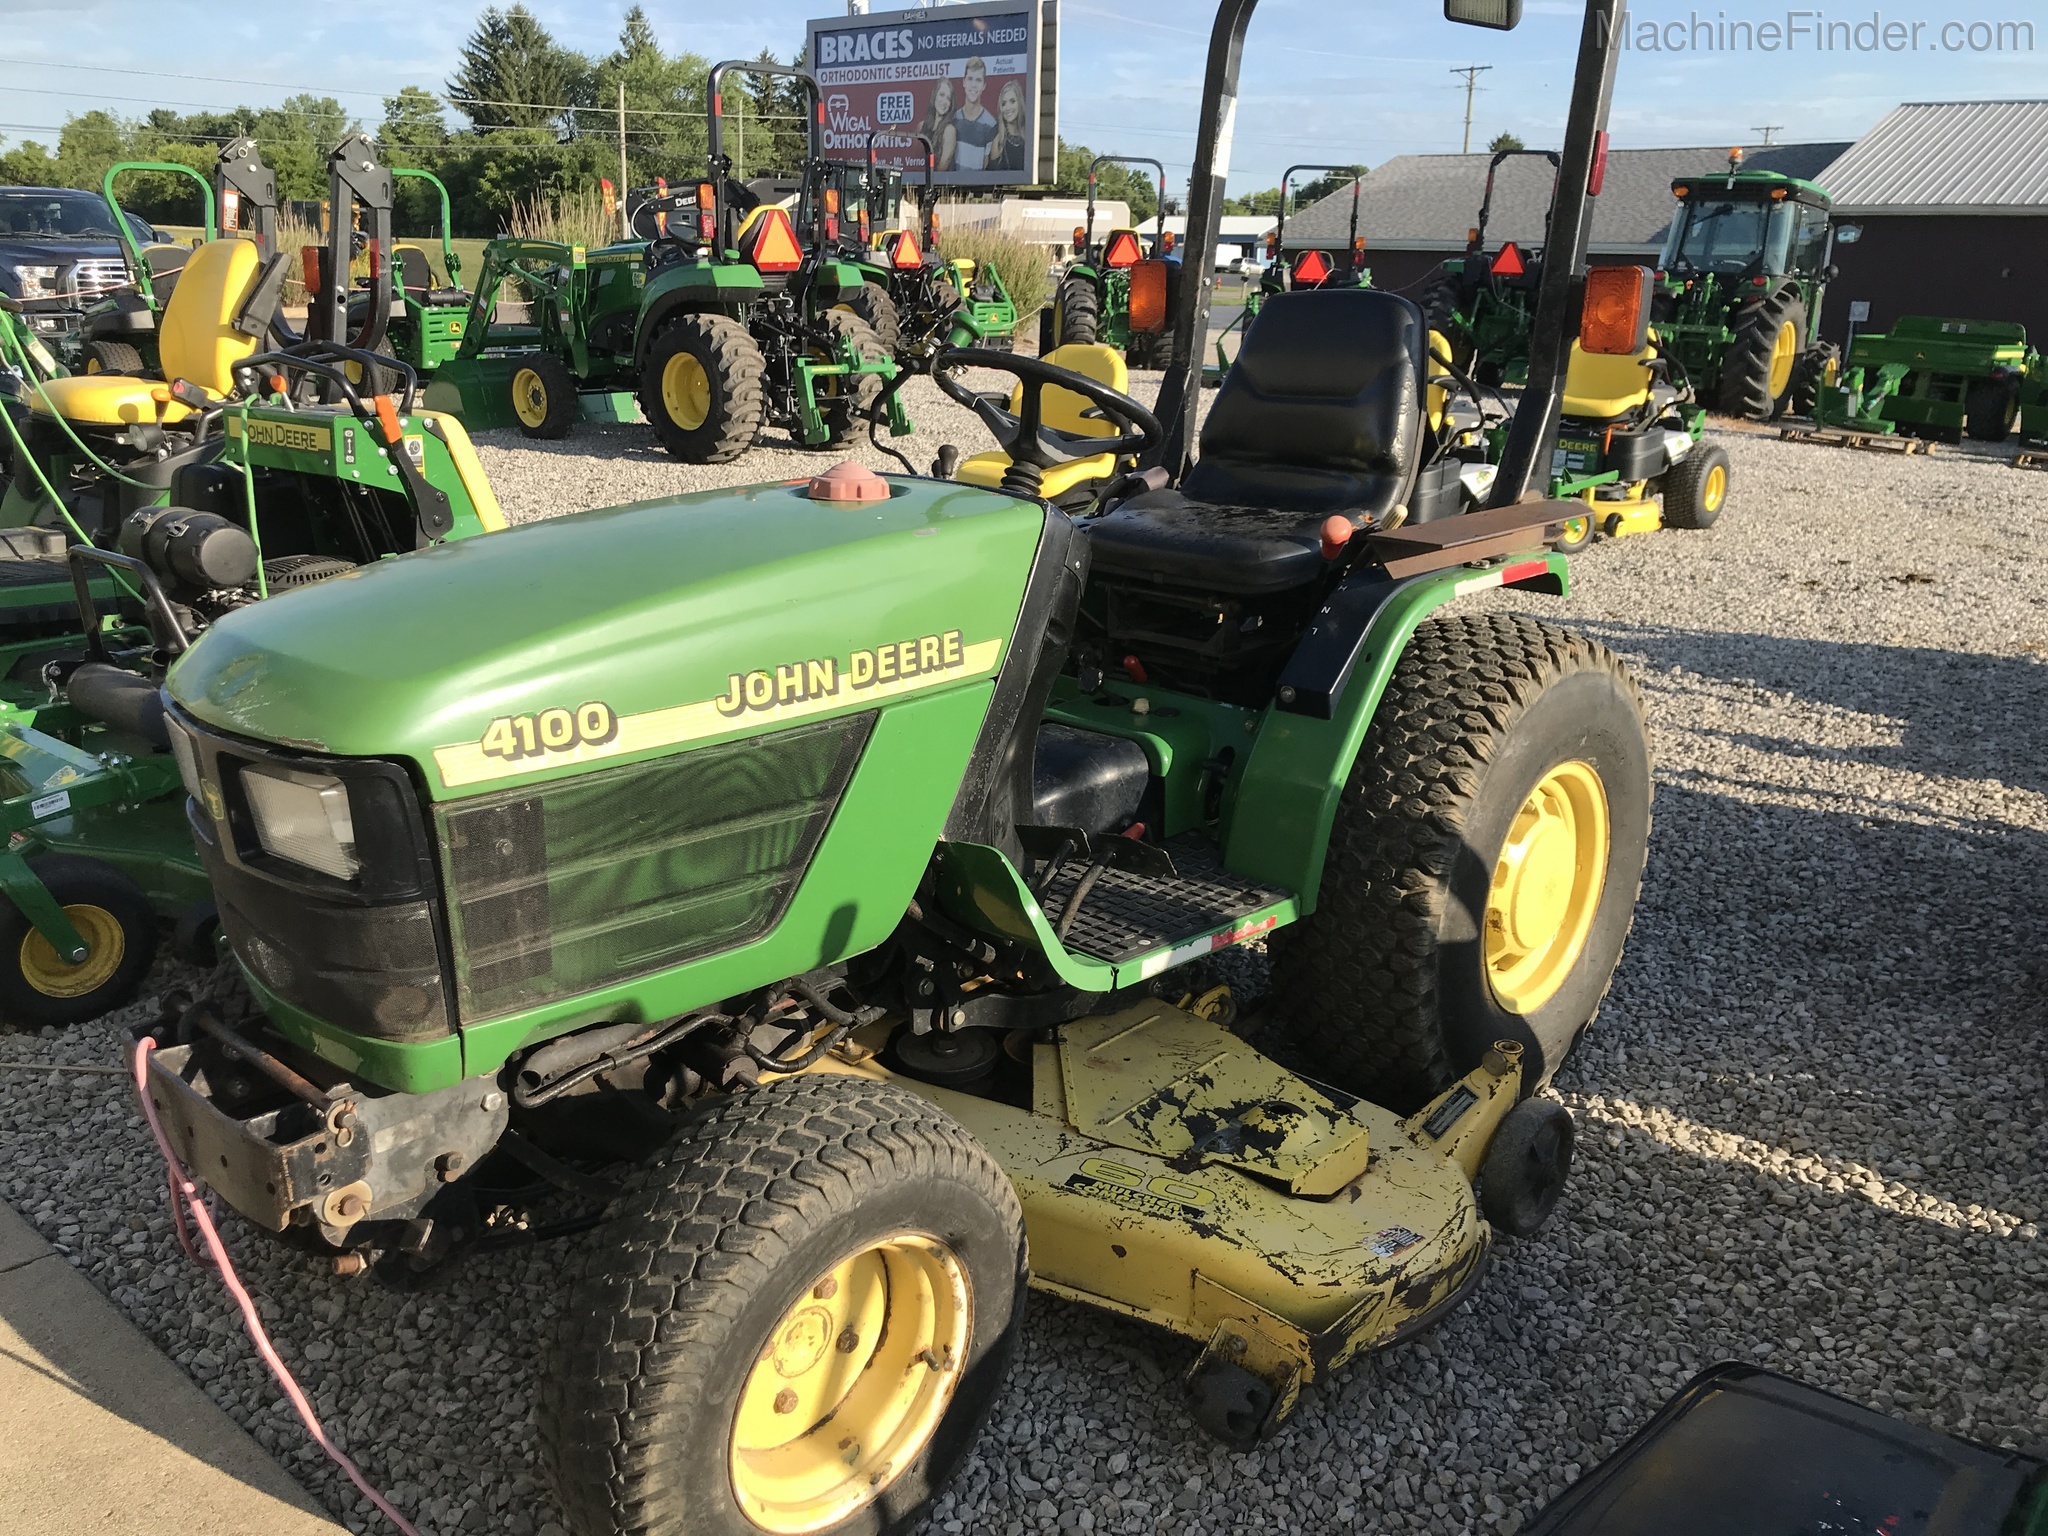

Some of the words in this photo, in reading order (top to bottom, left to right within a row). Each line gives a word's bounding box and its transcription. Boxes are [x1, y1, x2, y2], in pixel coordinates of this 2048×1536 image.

[820, 28, 914, 64] BRACES
[917, 36, 934, 49] NO
[936, 31, 984, 48] REFERRALS
[987, 27, 1027, 44] NEEDED
[995, 57, 1014, 65] Actual
[820, 67, 892, 83] ORTHODONTIC
[894, 63, 950, 79] SPECIALIST
[992, 65, 1015, 74] Patients
[880, 95, 911, 109] FREE
[880, 109, 911, 121] EXAM
[905, 156, 926, 167] Verno
[246, 423, 275, 444] OHN
[275, 424, 318, 449] DEERE
[1559, 438, 1597, 452] DEERE
[1320, 606, 1331, 614] N
[716, 658, 838, 716] JOHN
[850, 629, 964, 689] DEERE
[482, 702, 618, 760] 4100
[1079, 1157, 1217, 1206] 60
